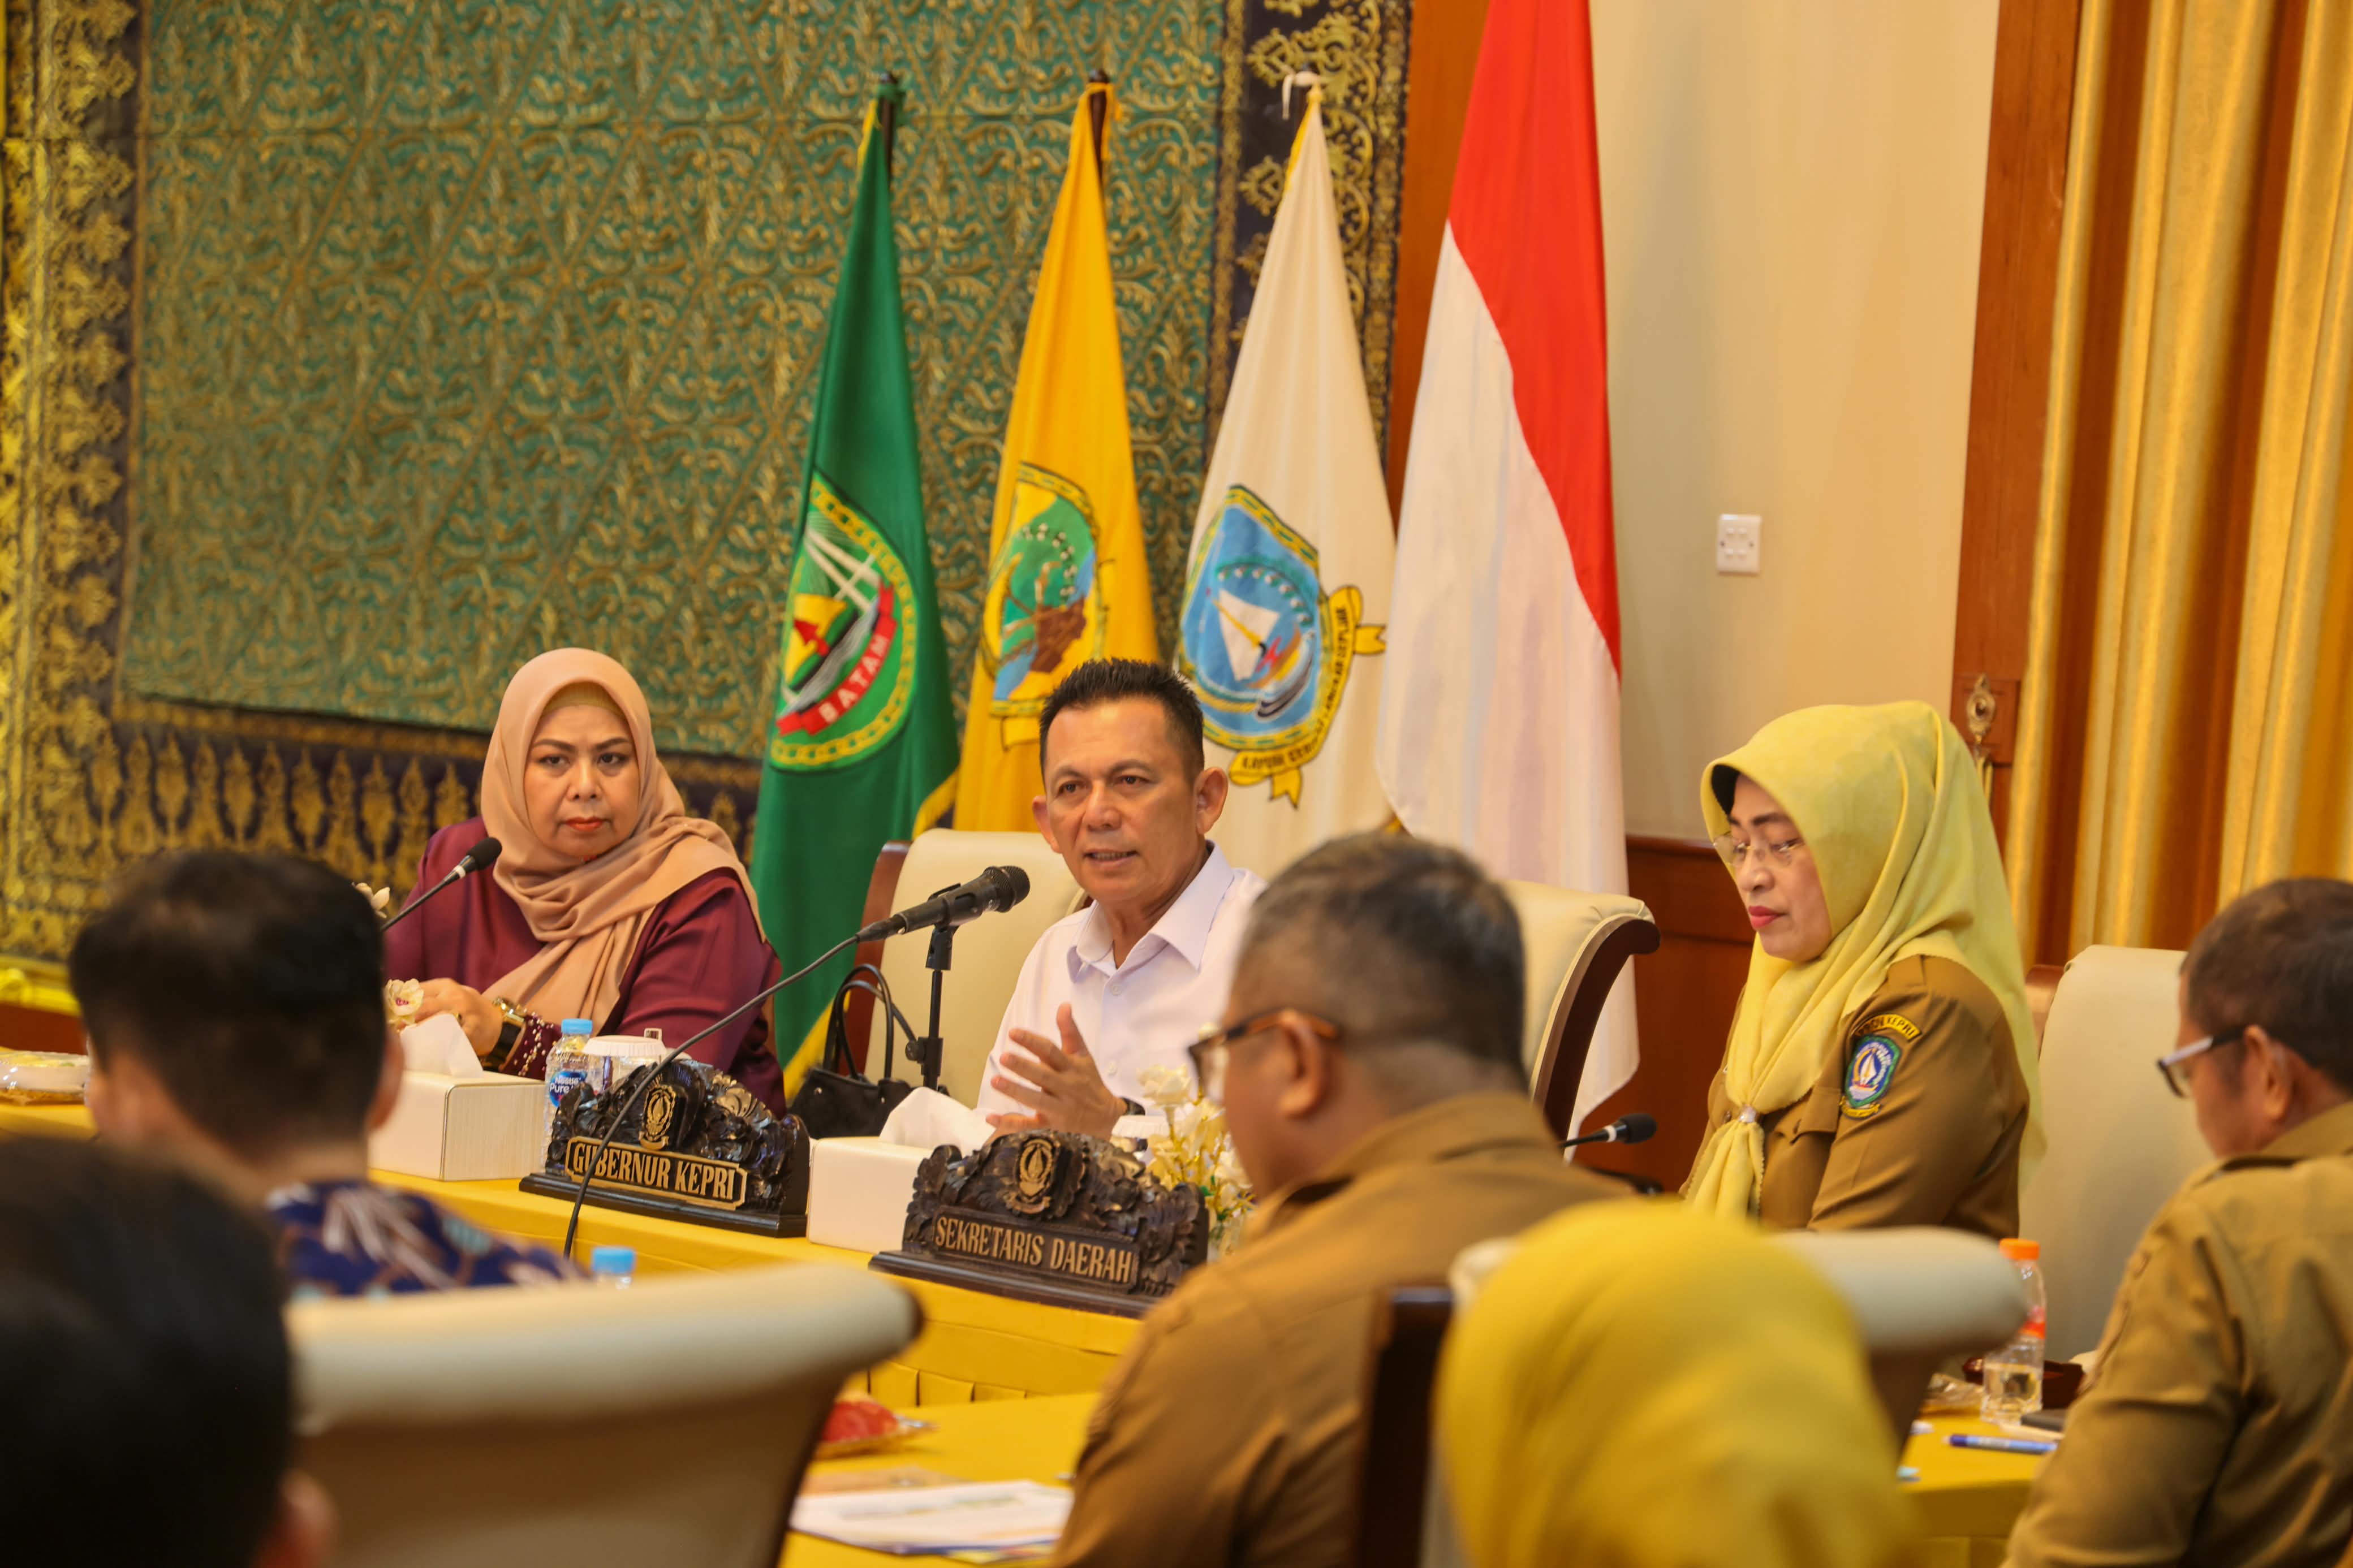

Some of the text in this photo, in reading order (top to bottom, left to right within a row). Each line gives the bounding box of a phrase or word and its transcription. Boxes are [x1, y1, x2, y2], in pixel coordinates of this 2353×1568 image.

[818, 634, 890, 723] BATAM
[550, 1083, 570, 1094] Pure
[573, 1143, 735, 1199] GUBERNUR KEPRI
[936, 1216, 1132, 1283] SEKRETARIS DAERAH
